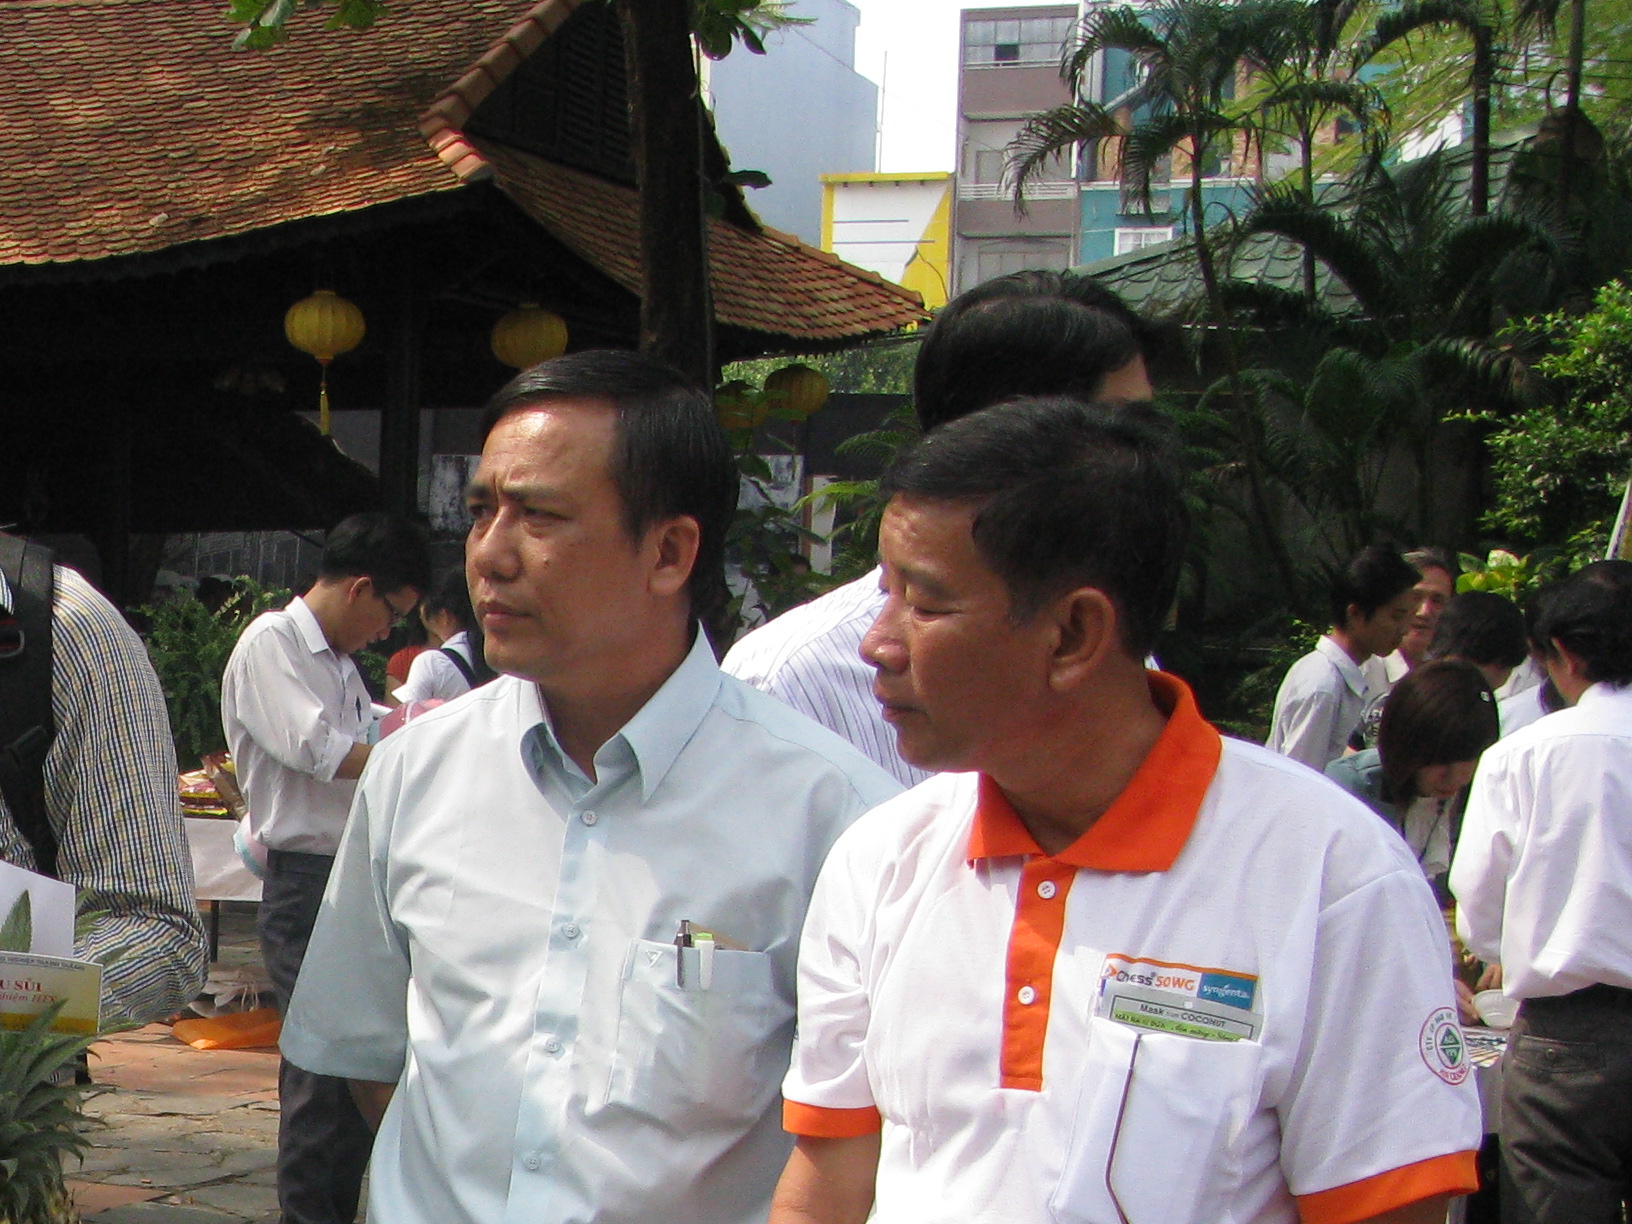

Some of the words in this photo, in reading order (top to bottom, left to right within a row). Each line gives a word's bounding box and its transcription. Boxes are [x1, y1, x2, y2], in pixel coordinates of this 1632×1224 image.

[1154, 974, 1196, 993] 50WG
[1139, 1004, 1164, 1016] Mask
[1180, 1012, 1226, 1029] COCONUT
